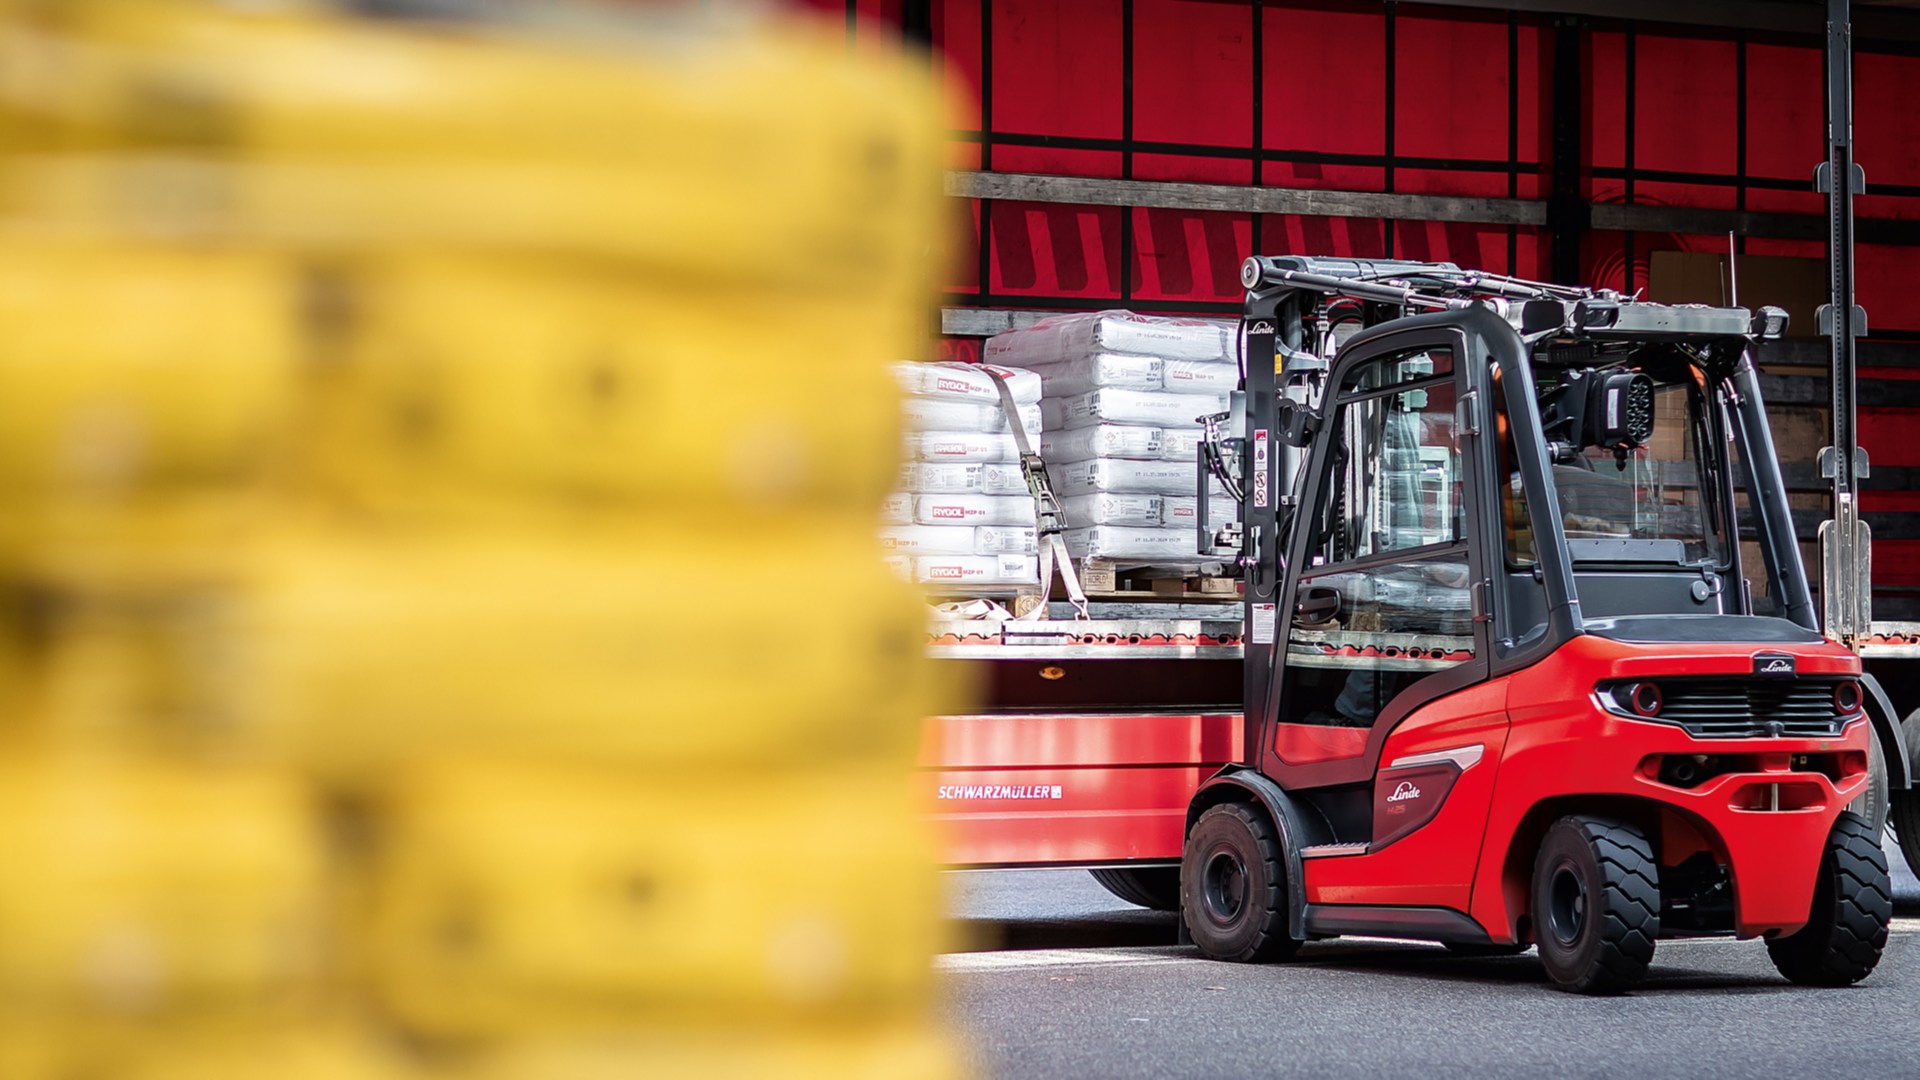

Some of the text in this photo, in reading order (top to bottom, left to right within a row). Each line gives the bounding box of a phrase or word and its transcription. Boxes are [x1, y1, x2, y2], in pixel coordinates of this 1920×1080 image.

[1247, 321, 1275, 335] Linde
[938, 379, 969, 392] RYGOL
[932, 506, 964, 517] RYGOL
[930, 567, 962, 578] RYGOL
[1761, 659, 1792, 672] Linde
[938, 785, 1050, 799] SCHWARZMÜLLER
[1387, 781, 1420, 802] Linde
